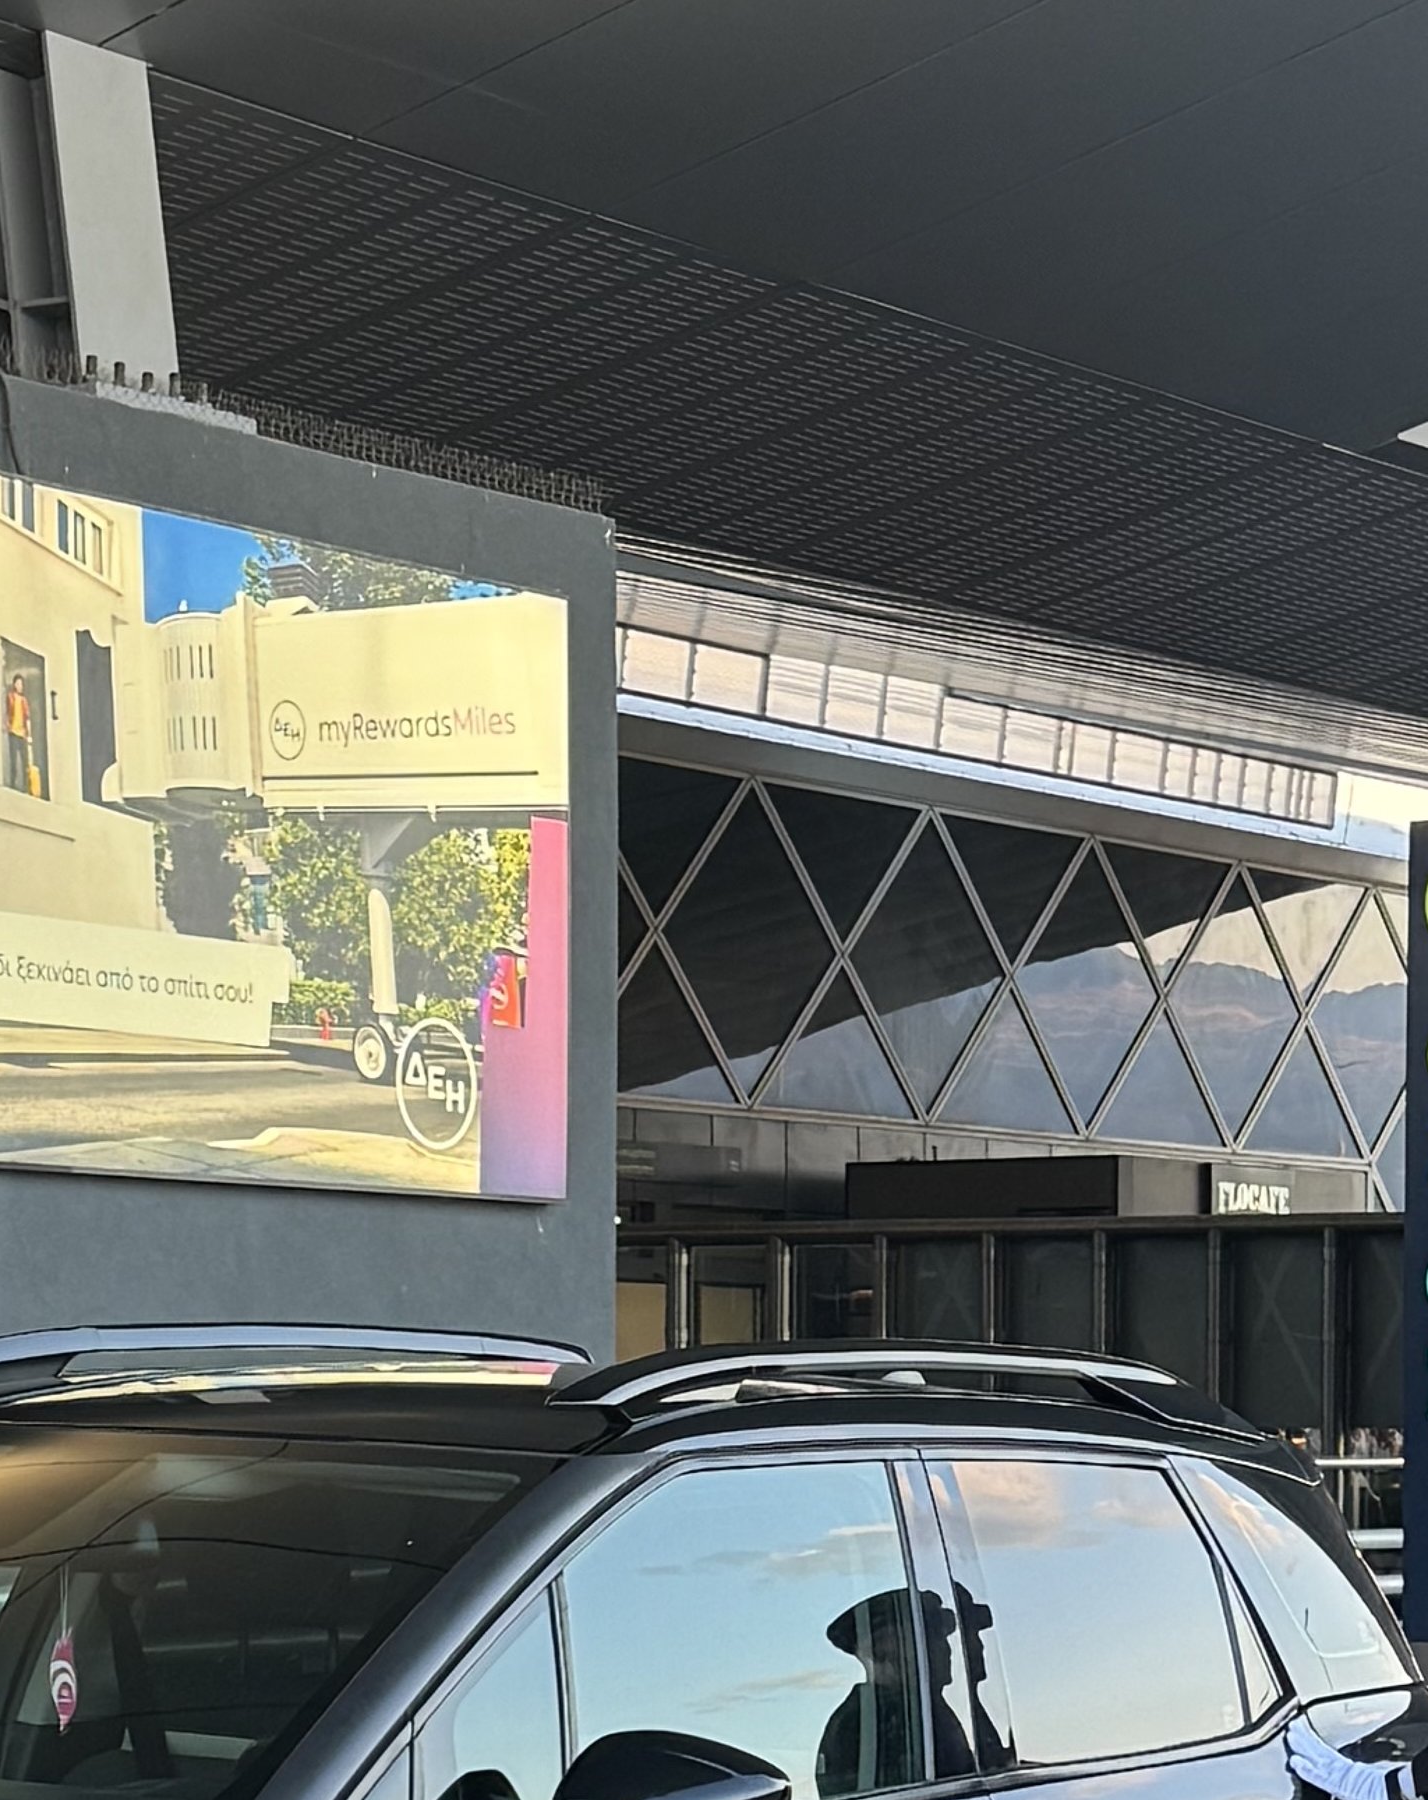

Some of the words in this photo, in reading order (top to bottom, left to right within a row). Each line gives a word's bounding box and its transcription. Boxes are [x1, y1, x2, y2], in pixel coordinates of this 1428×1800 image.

[318, 705, 517, 748] myRewardsMiles
[17, 956, 91, 986] ξεκινάει
[96, 967, 133, 991] από
[139, 975, 160, 993] το
[164, 974, 210, 1000] σπίτι
[214, 983, 253, 1003] σου!
[405, 1051, 465, 1114] ΔΕΗ
